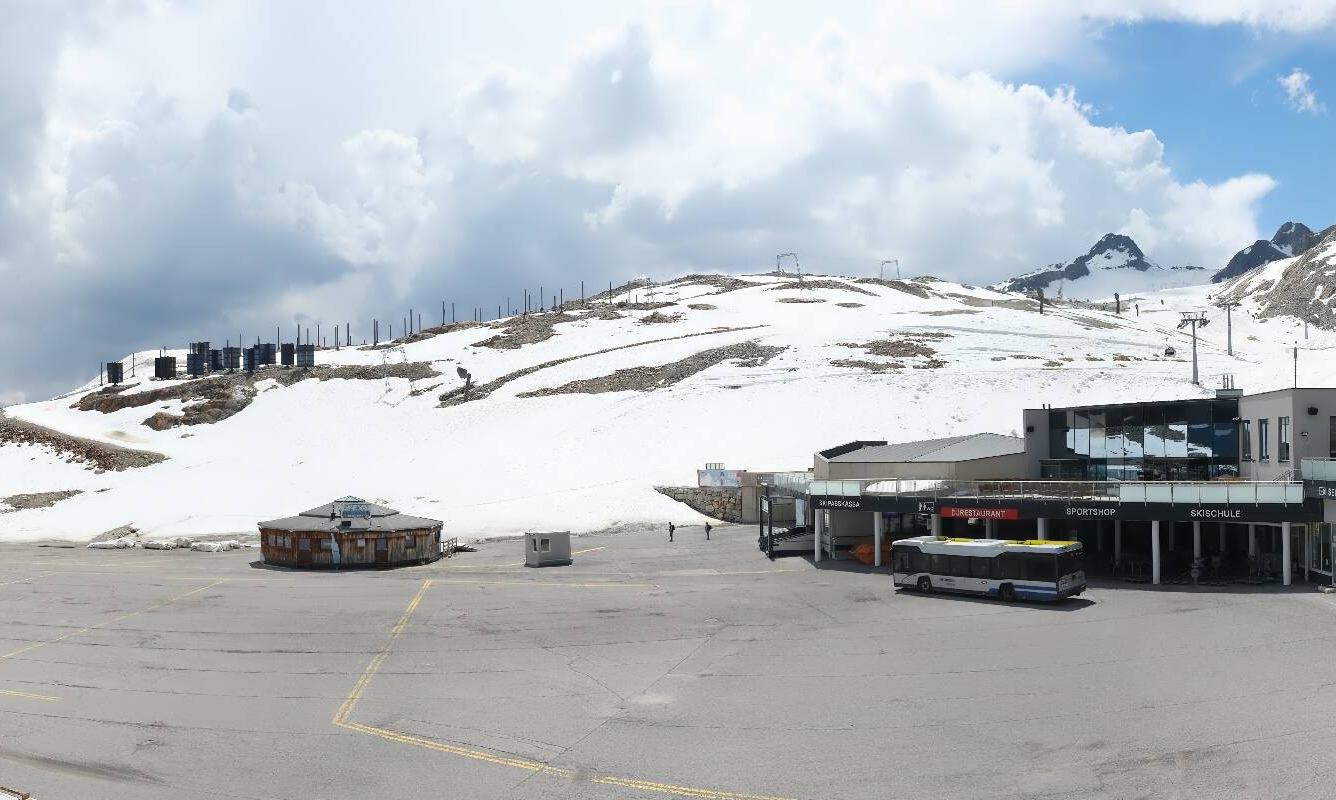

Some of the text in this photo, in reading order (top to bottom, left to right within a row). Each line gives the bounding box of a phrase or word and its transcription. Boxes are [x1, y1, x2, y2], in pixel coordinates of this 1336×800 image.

[959, 508, 1006, 517] RESTAURANT
[1066, 508, 1116, 516] SPORTSHOP
[1190, 509, 1241, 518] SKISCHULE
